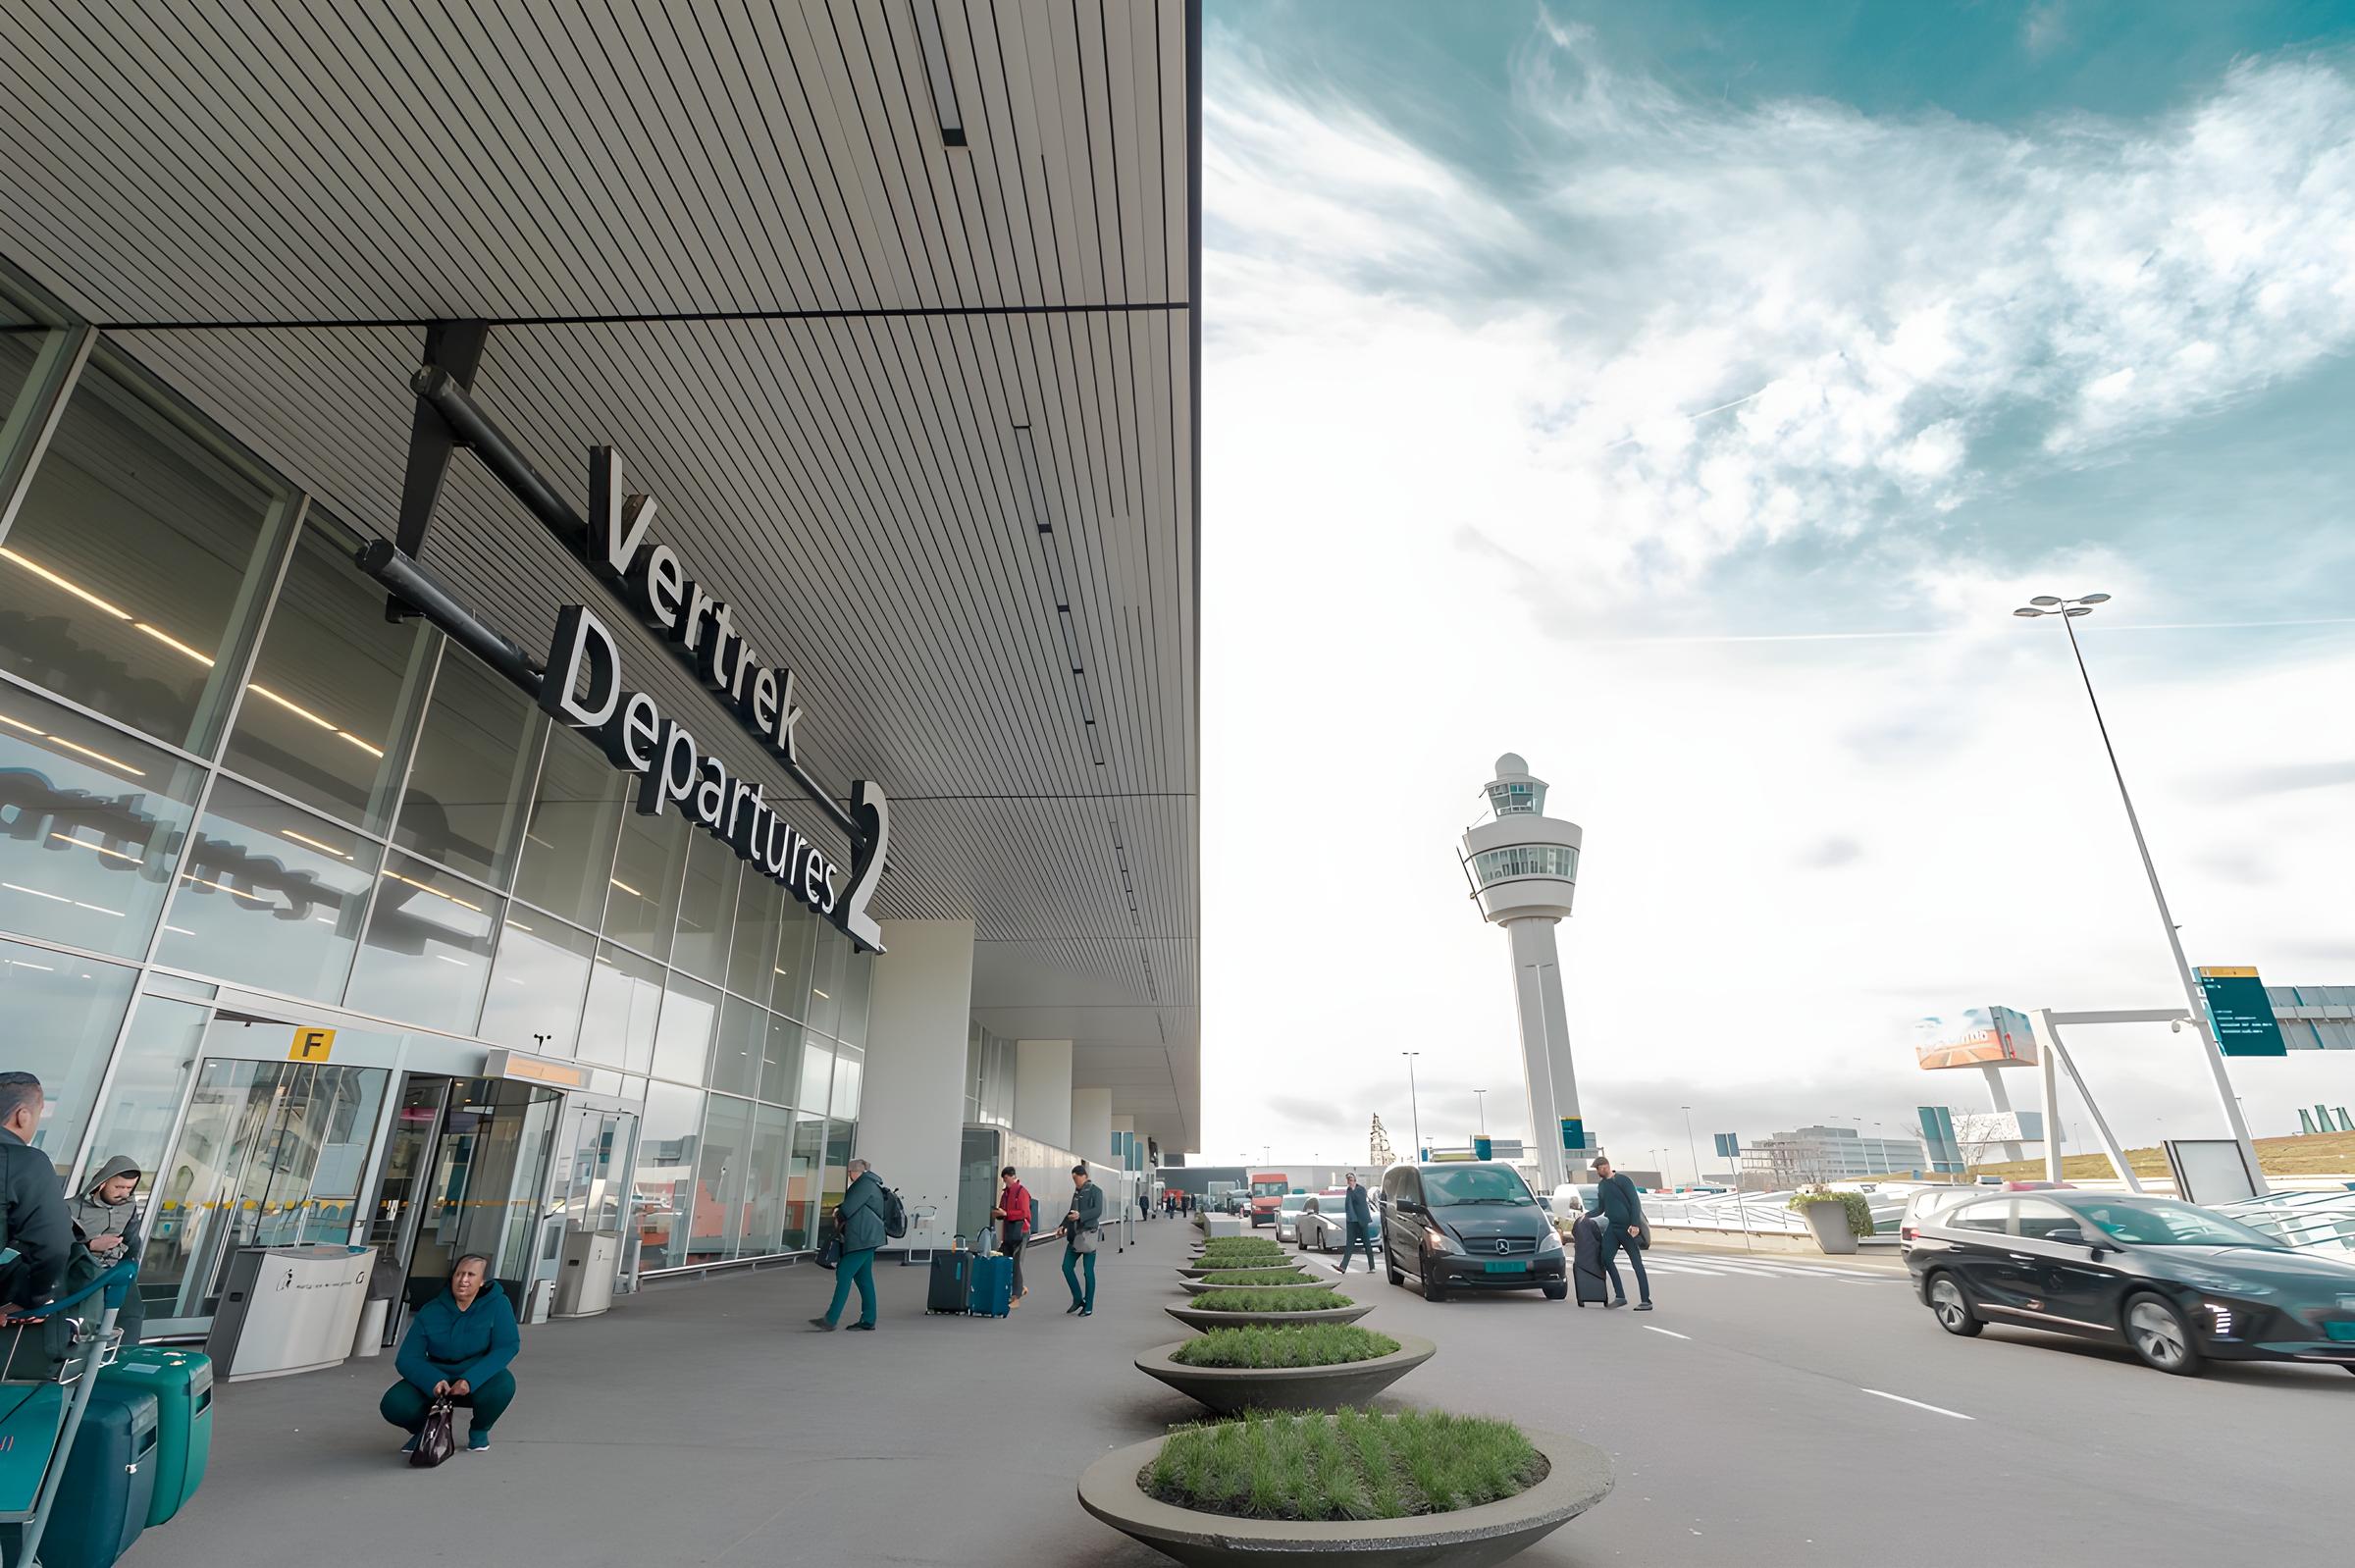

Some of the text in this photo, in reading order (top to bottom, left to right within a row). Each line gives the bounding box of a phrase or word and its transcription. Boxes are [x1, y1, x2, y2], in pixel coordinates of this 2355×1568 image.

[604, 446, 803, 765] Vertrek
[559, 605, 838, 914] Departures
[846, 781, 888, 952] 2
[302, 1033, 325, 1057] F
